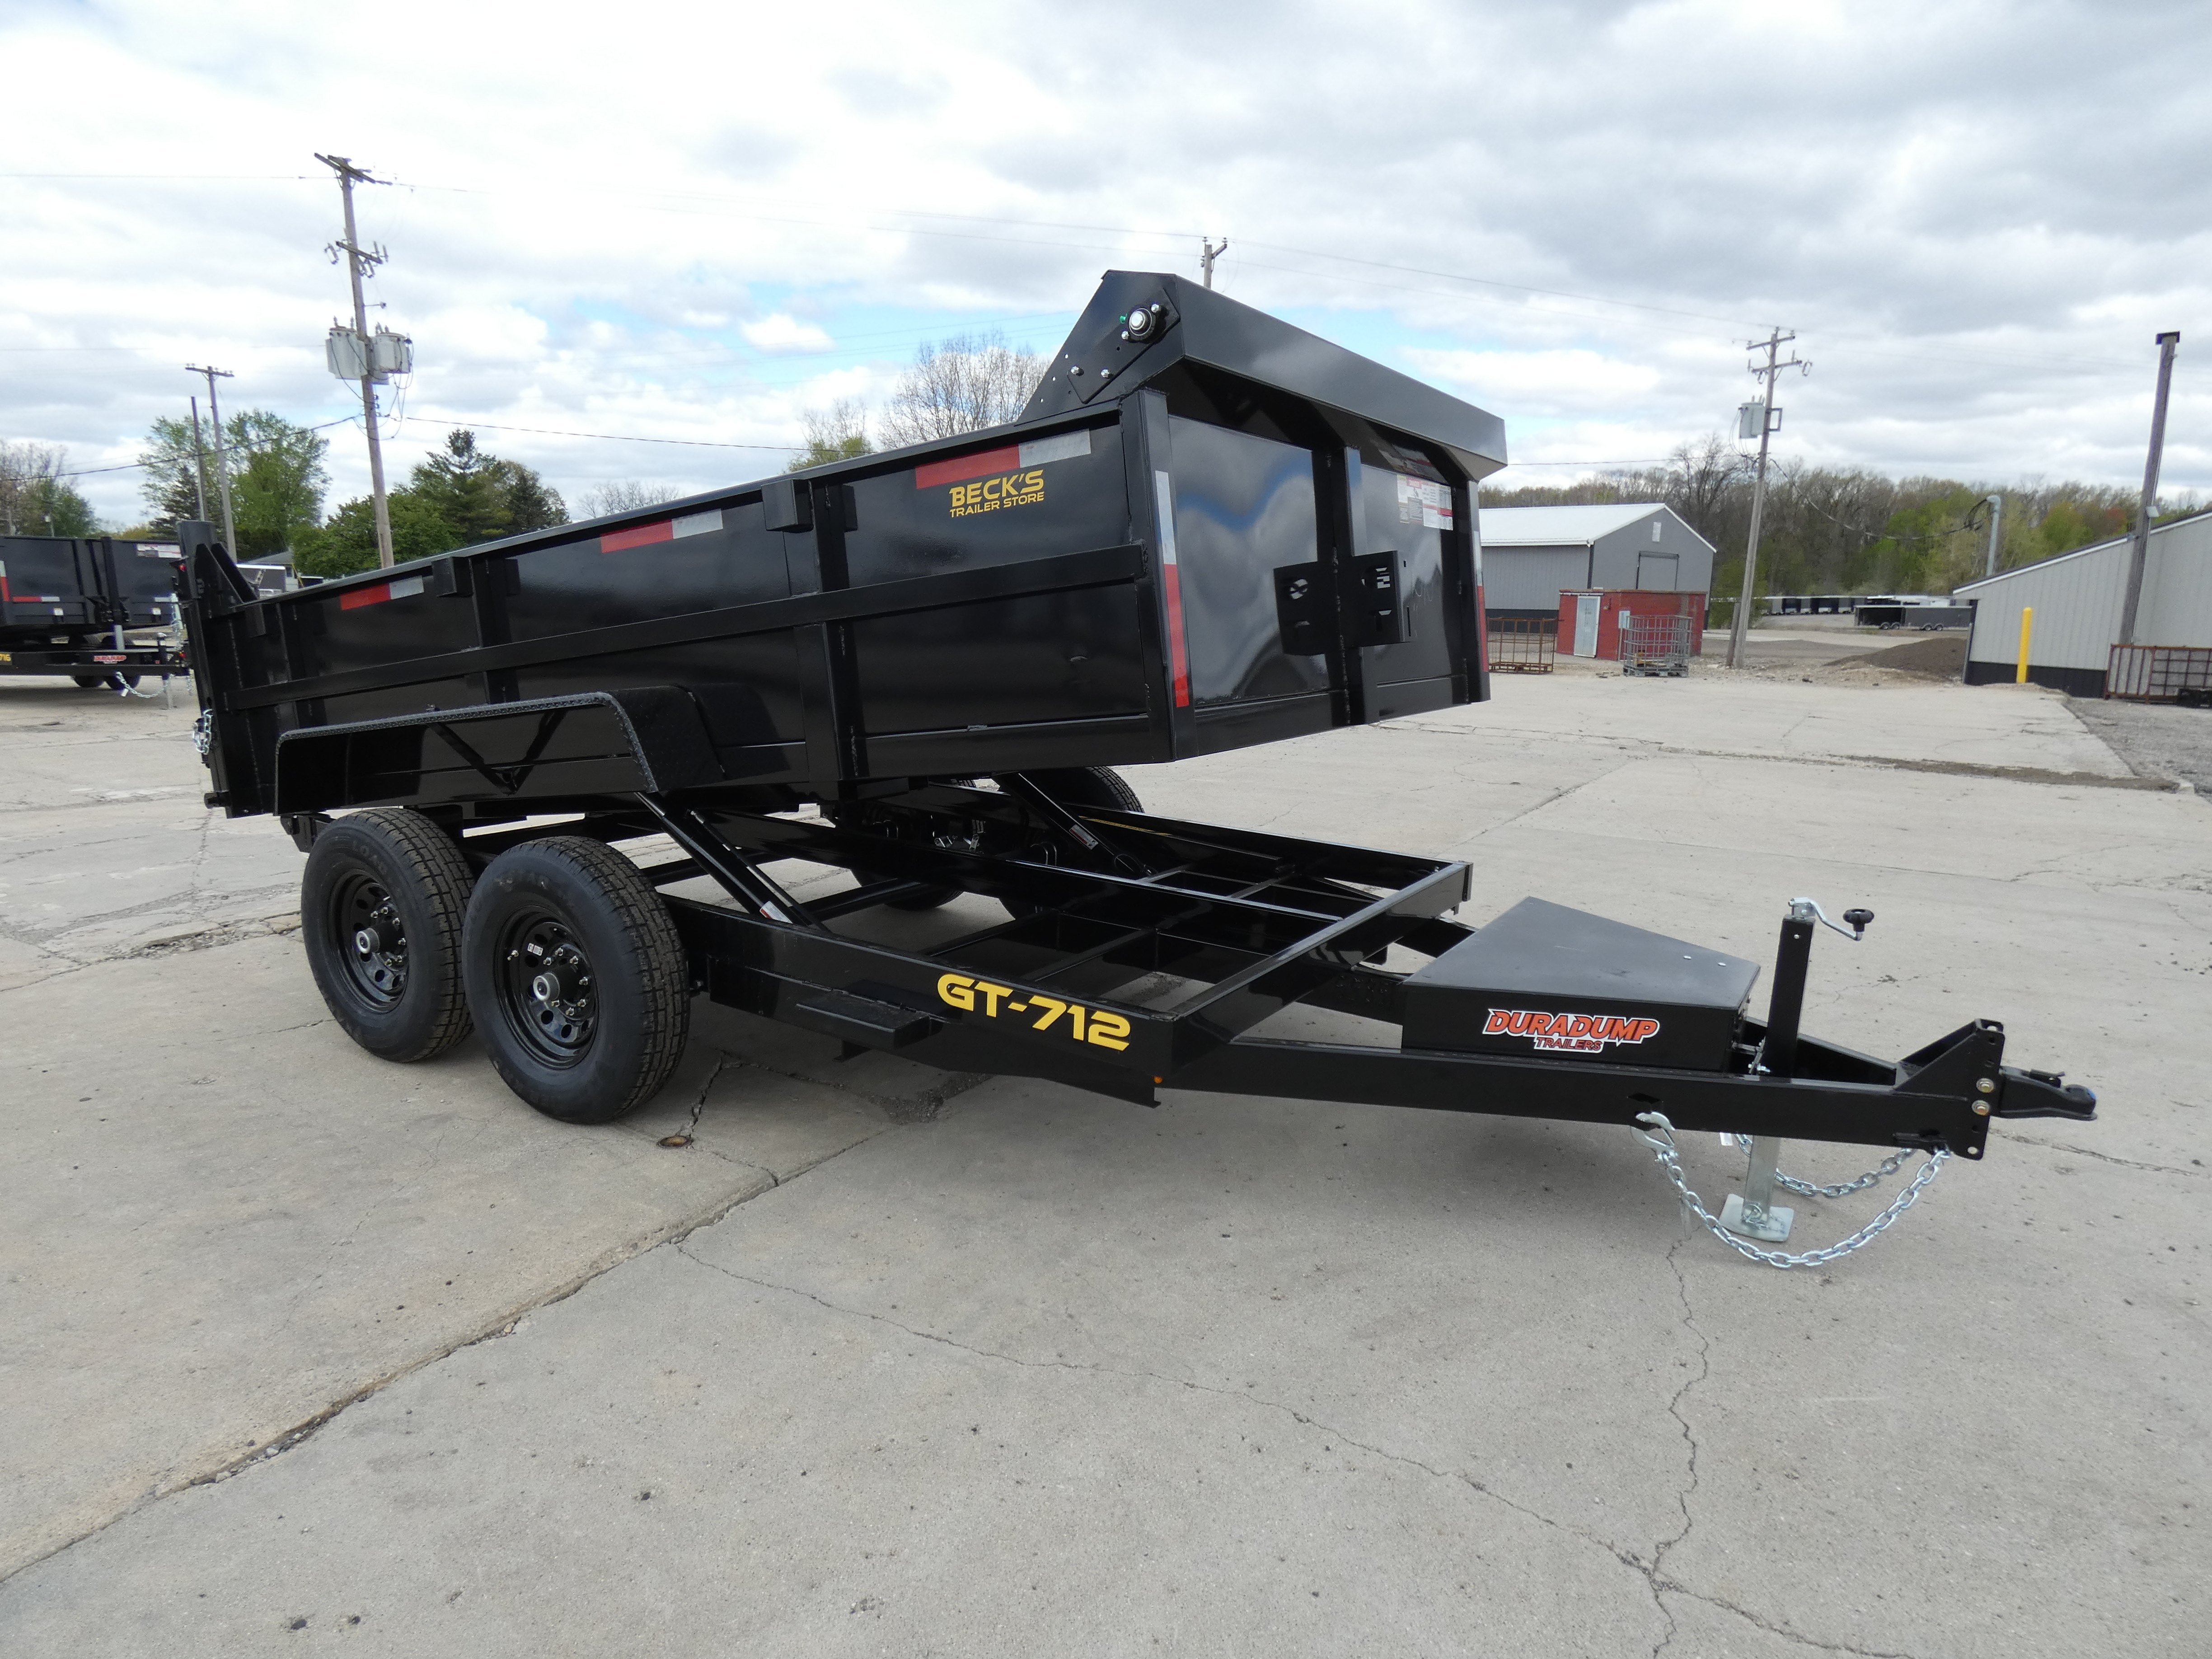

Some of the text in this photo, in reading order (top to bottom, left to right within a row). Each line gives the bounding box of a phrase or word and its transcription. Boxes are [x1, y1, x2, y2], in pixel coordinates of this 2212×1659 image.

[949, 469, 1044, 507] BECK'S
[950, 491, 1045, 518] TRAILER STORE
[937, 974, 1130, 1051] GT-712
[1484, 1010, 1659, 1042] DURADUMP
[1536, 1037, 1603, 1052] TRAILERS
